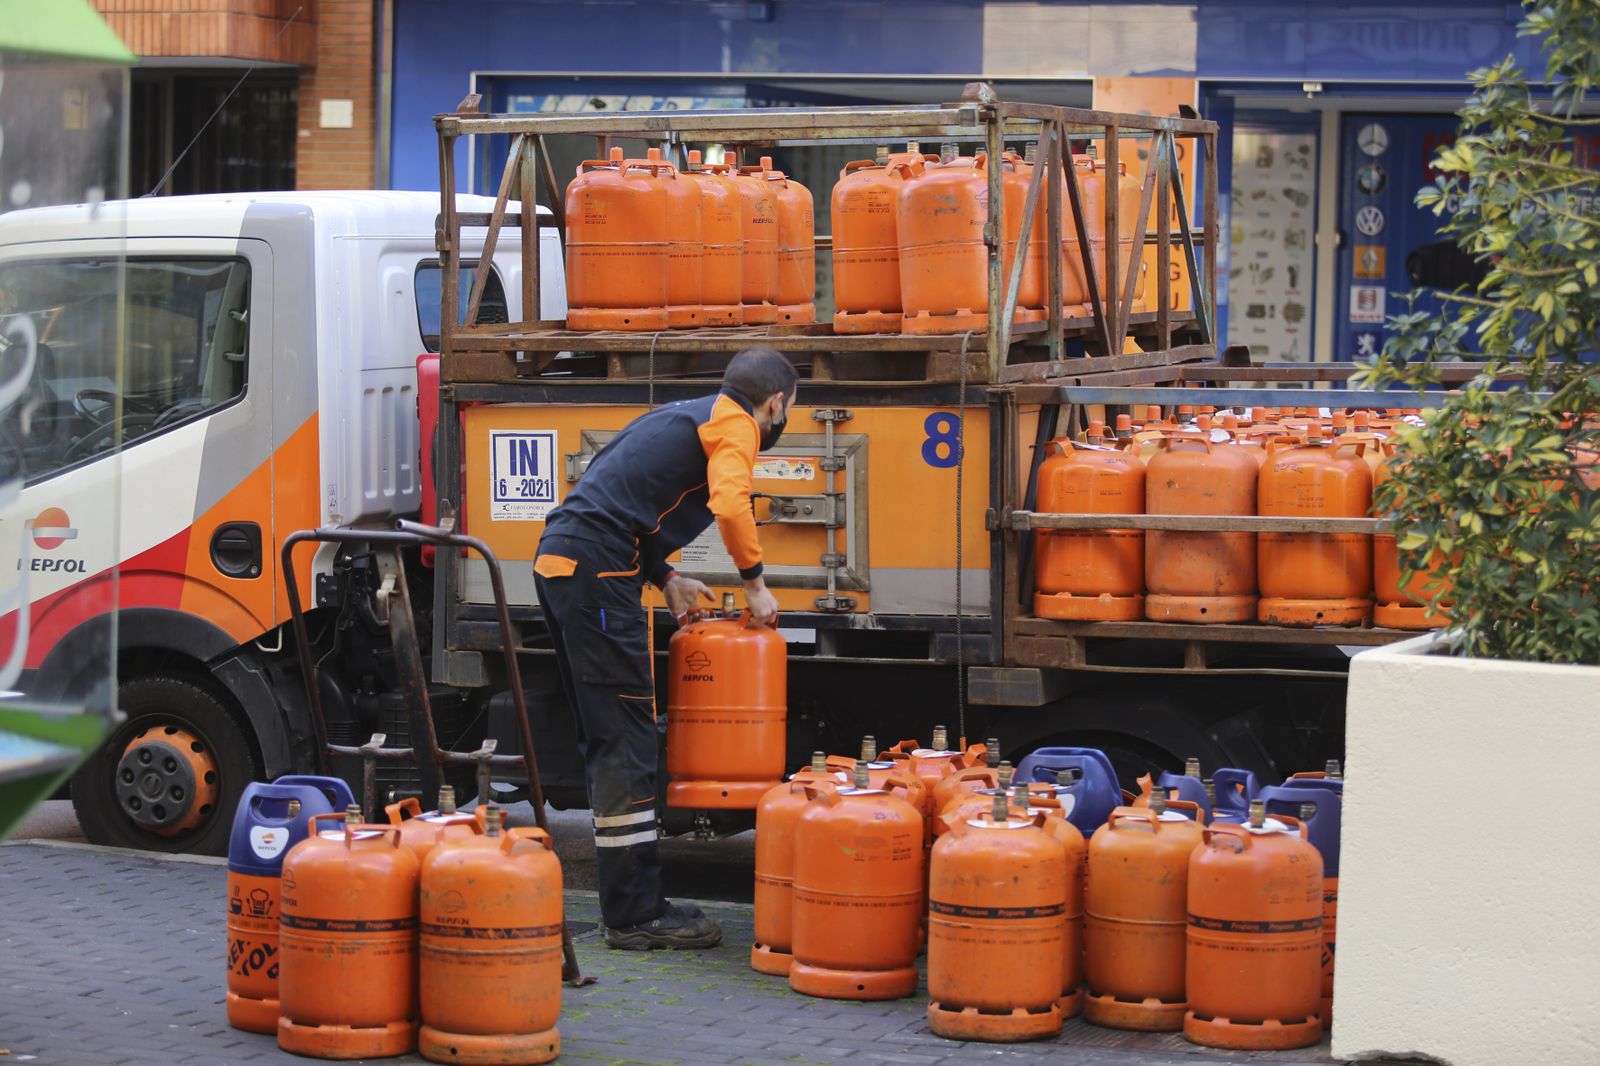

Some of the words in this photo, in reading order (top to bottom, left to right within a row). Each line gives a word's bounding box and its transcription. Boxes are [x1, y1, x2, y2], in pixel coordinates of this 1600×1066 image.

[922, 412, 964, 468] 8
[509, 439, 539, 476] IN
[499, 478, 507, 497] 6
[515, 478, 550, 497] -2021
[682, 674, 714, 682] REPSOL
